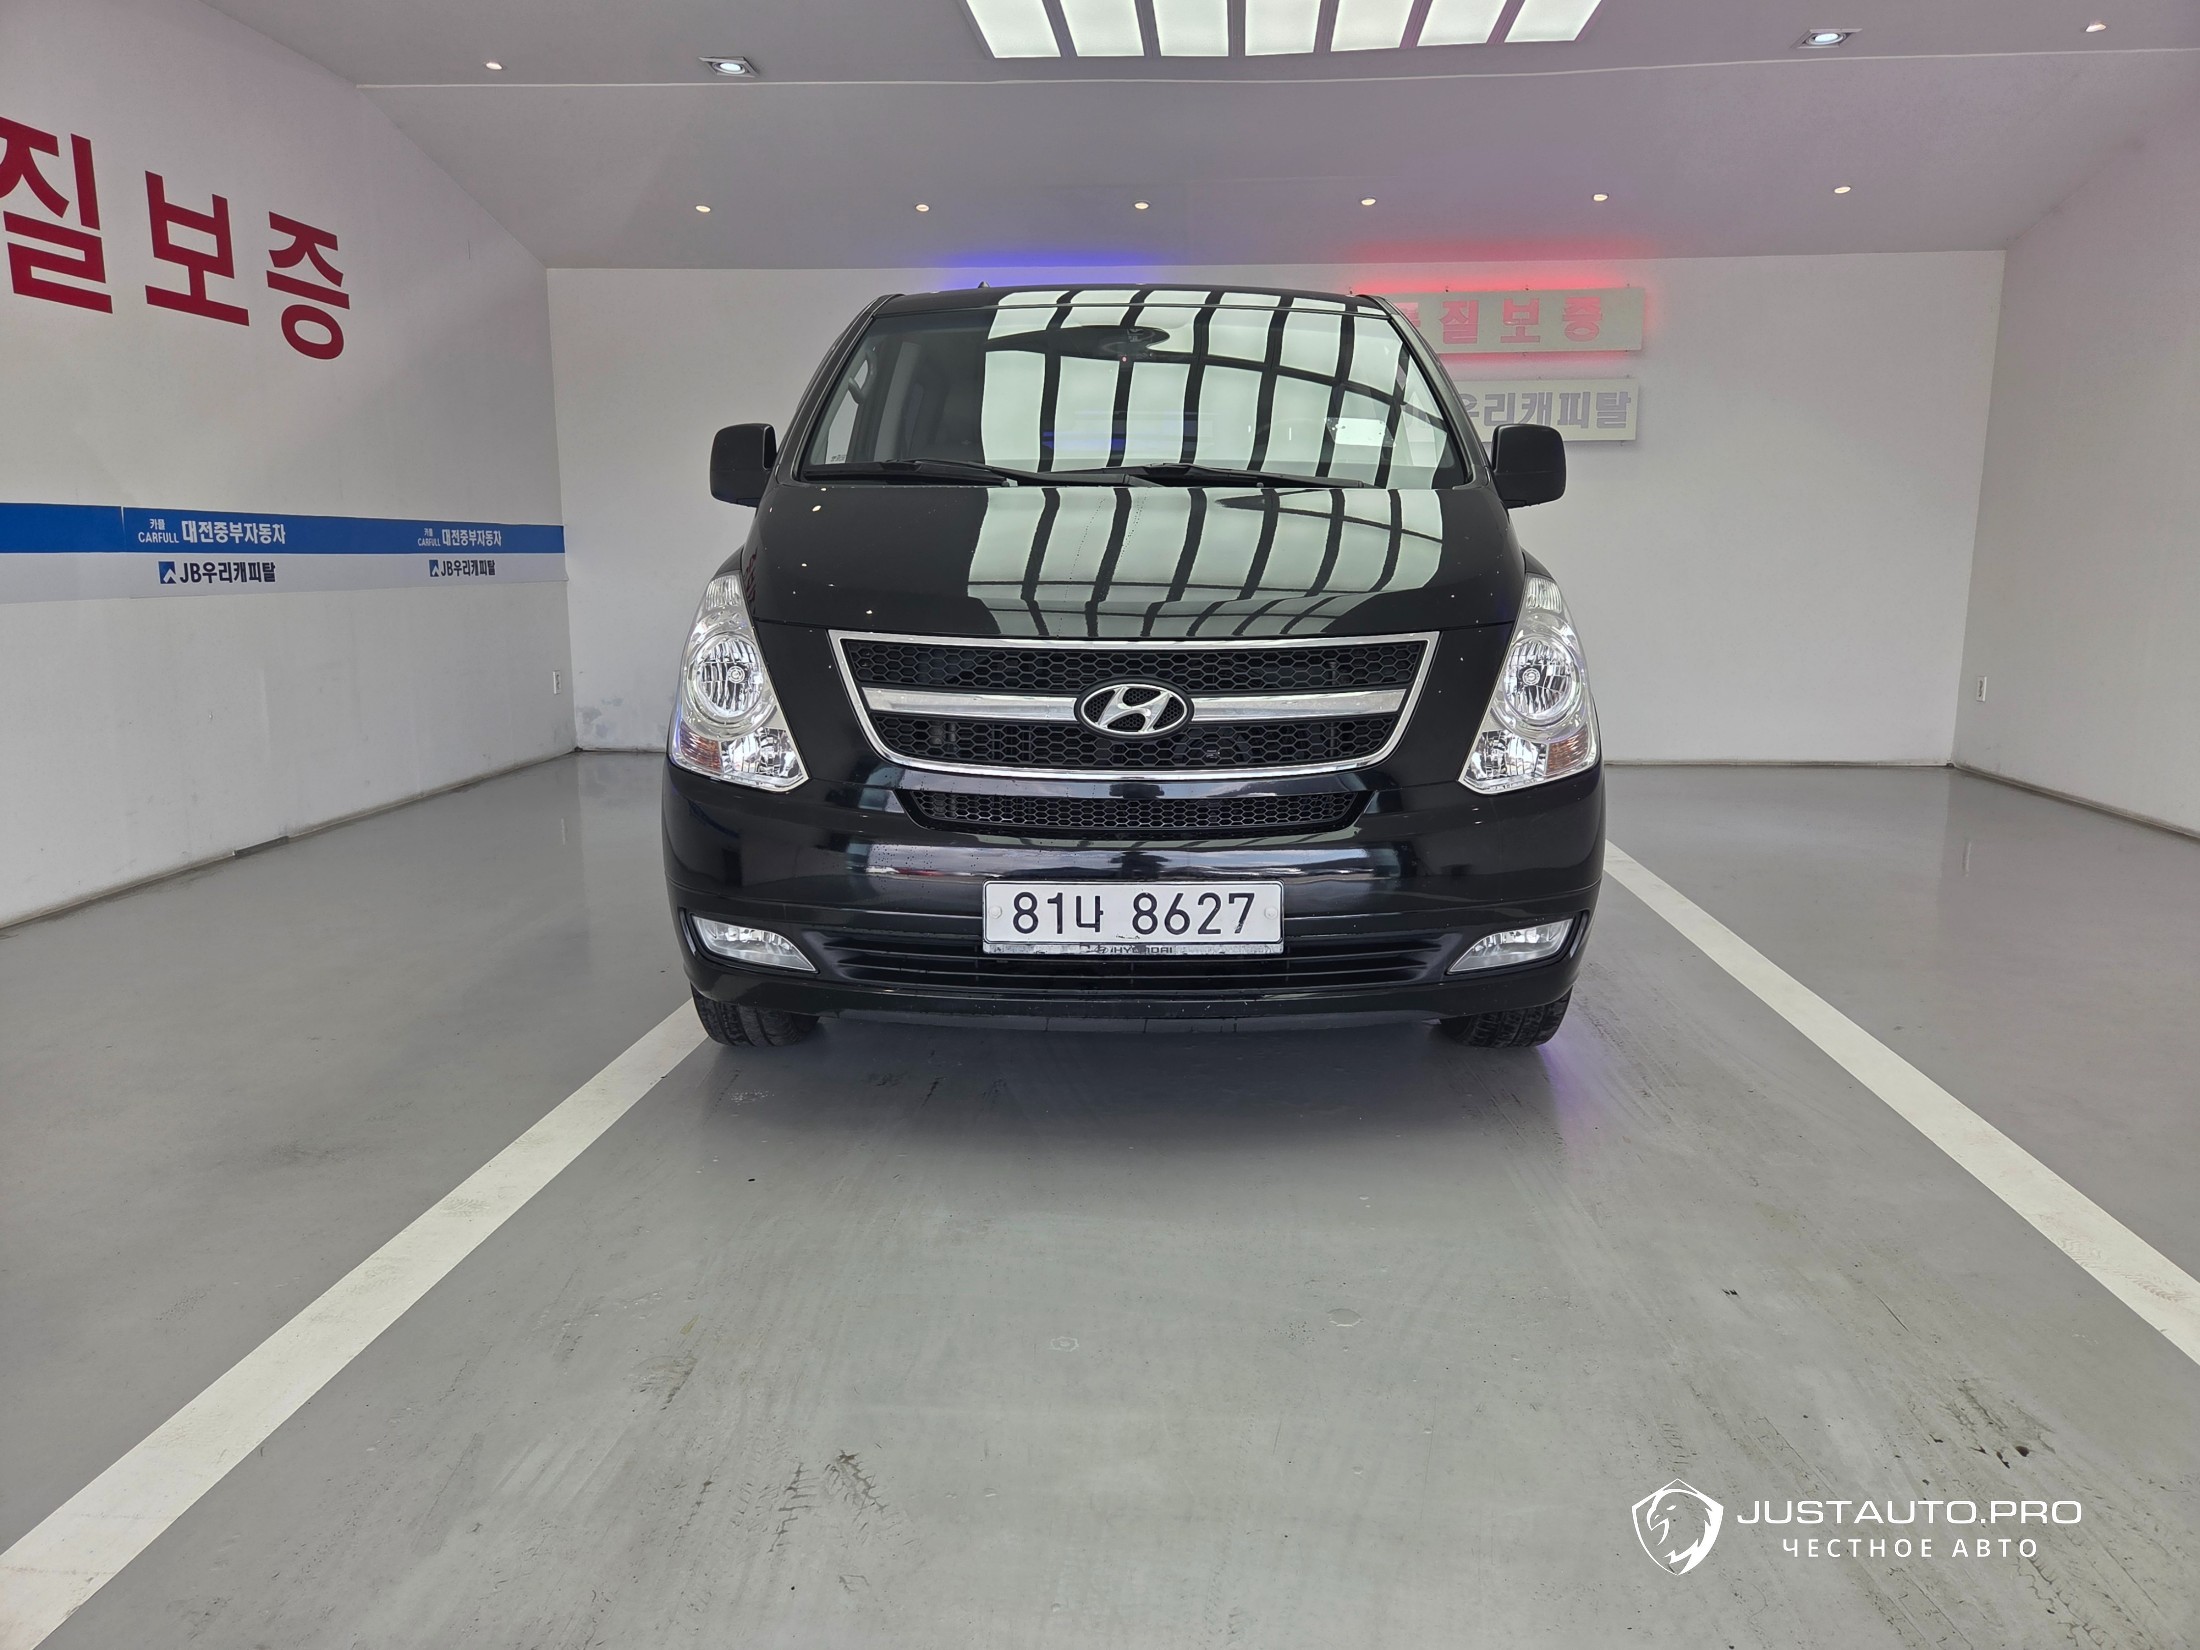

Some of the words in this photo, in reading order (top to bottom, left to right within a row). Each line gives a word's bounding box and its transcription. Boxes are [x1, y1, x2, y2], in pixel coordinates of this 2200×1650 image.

[138, 531, 180, 544] CARFULL
[181, 520, 286, 545] 대전중부자동차
[417, 537, 451, 547] CARFULL
[441, 528, 502, 547] 대전중부자동차
[179, 561, 276, 584] JB우리캐피탈
[440, 559, 496, 577] JB우리캐피탈
[1012, 891, 1104, 935] 81나
[1131, 892, 1255, 936] 8627
